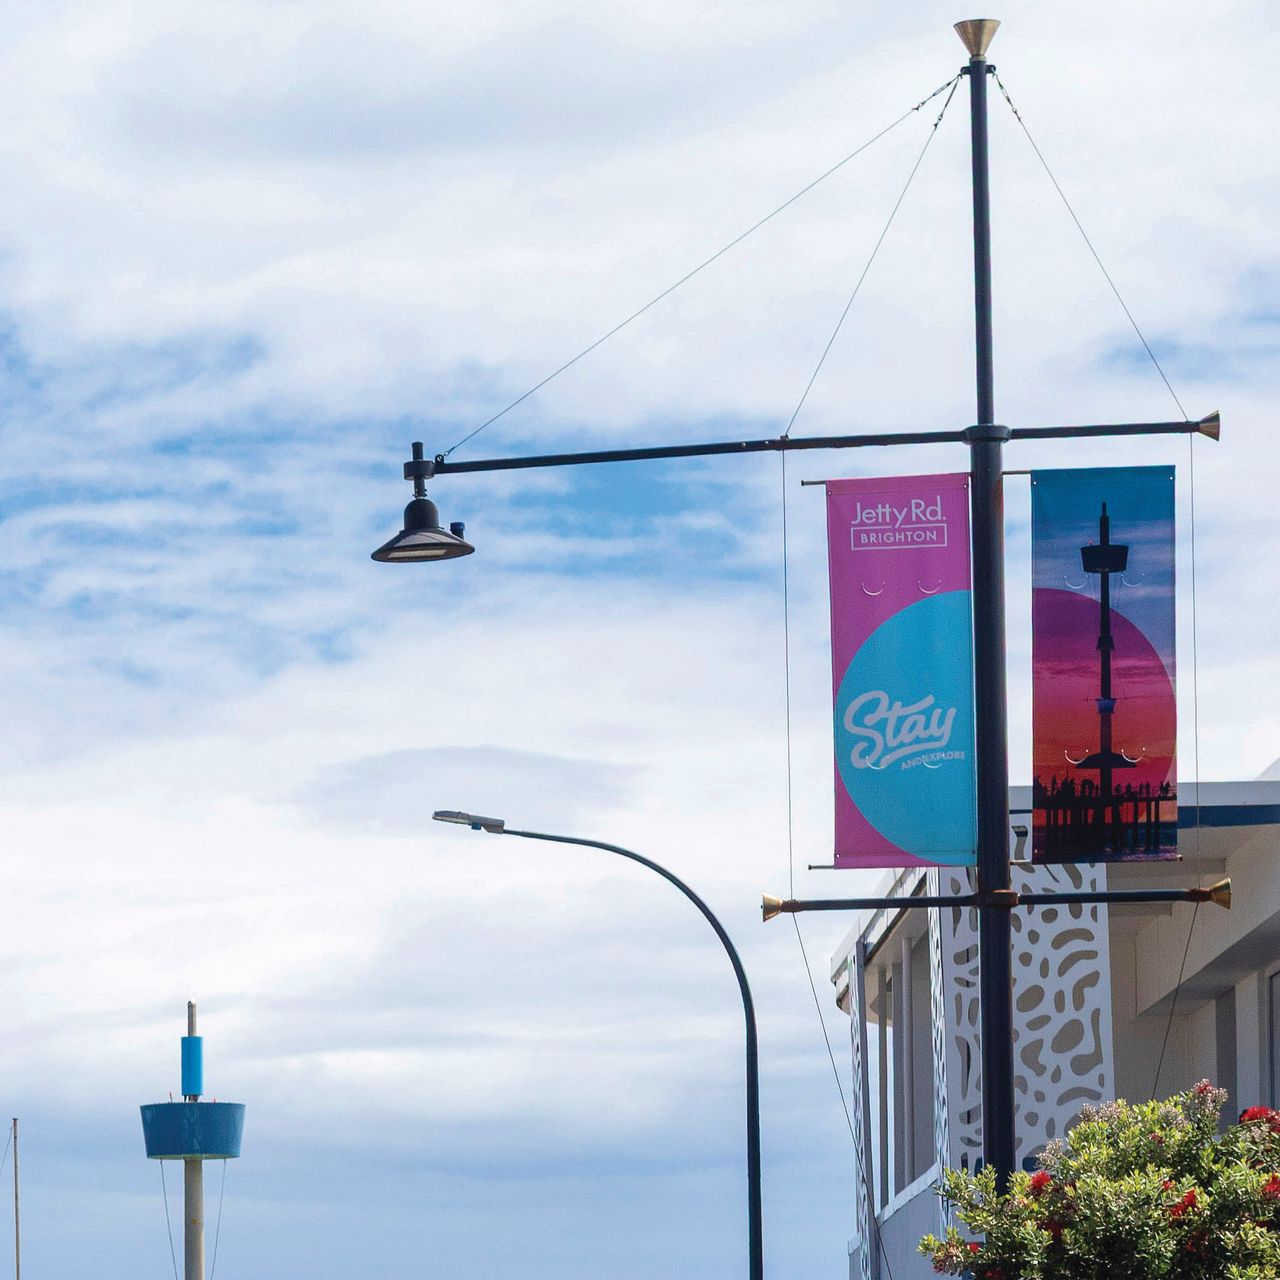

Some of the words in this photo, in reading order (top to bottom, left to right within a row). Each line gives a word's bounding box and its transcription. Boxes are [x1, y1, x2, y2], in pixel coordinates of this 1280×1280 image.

[851, 502, 908, 529] Jetty
[911, 495, 946, 521] Rd.
[860, 530, 937, 544] BRIGHTON
[843, 690, 957, 769] Stay
[901, 757, 921, 771] AND
[923, 750, 966, 763] EXPLORE
